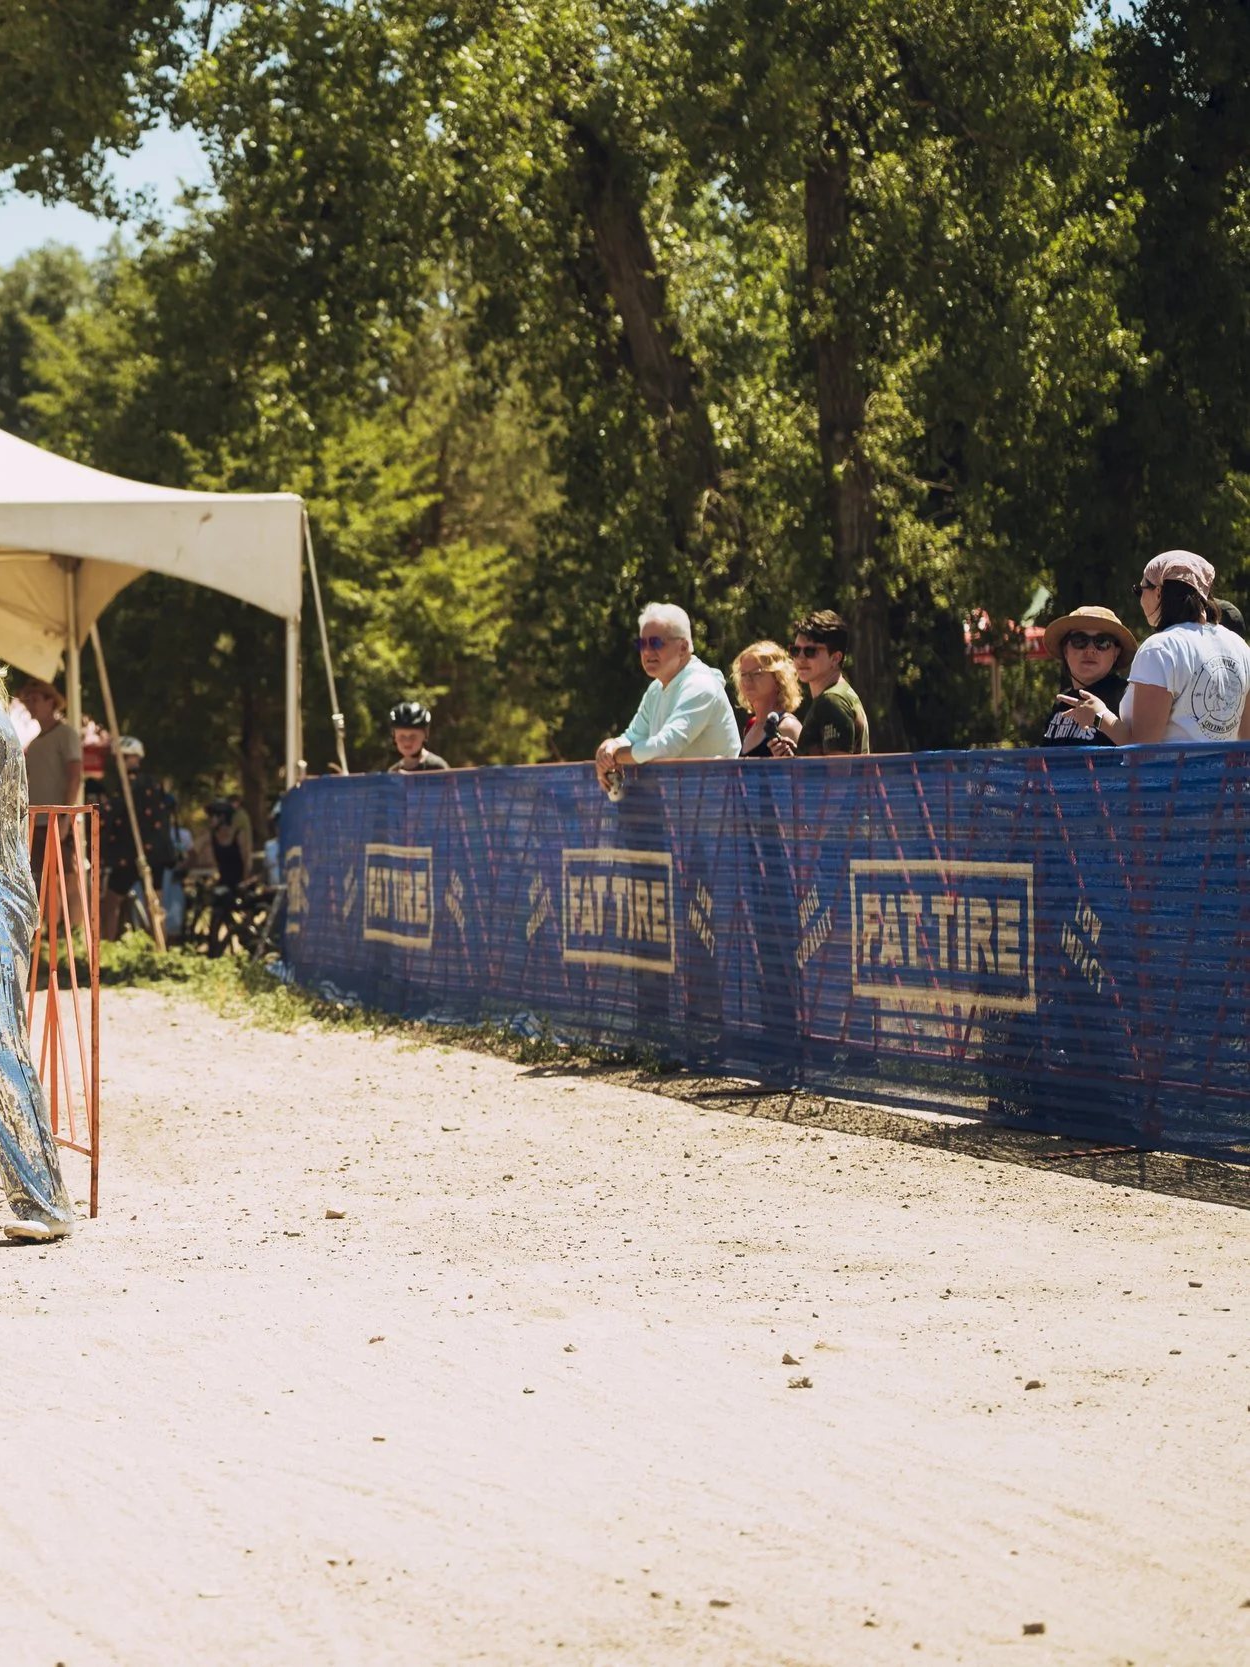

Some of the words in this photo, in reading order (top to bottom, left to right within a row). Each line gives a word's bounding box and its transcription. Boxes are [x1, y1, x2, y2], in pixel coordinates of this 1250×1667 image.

[368, 866, 390, 918] FAT
[392, 869, 428, 925] TIRE
[569, 875, 607, 936] FAT
[612, 877, 668, 944] TIRE
[1075, 895, 1102, 945] LOW
[862, 894, 922, 967] FAT
[931, 895, 1021, 976] TIRE
[1061, 921, 1105, 994] IMPACT
